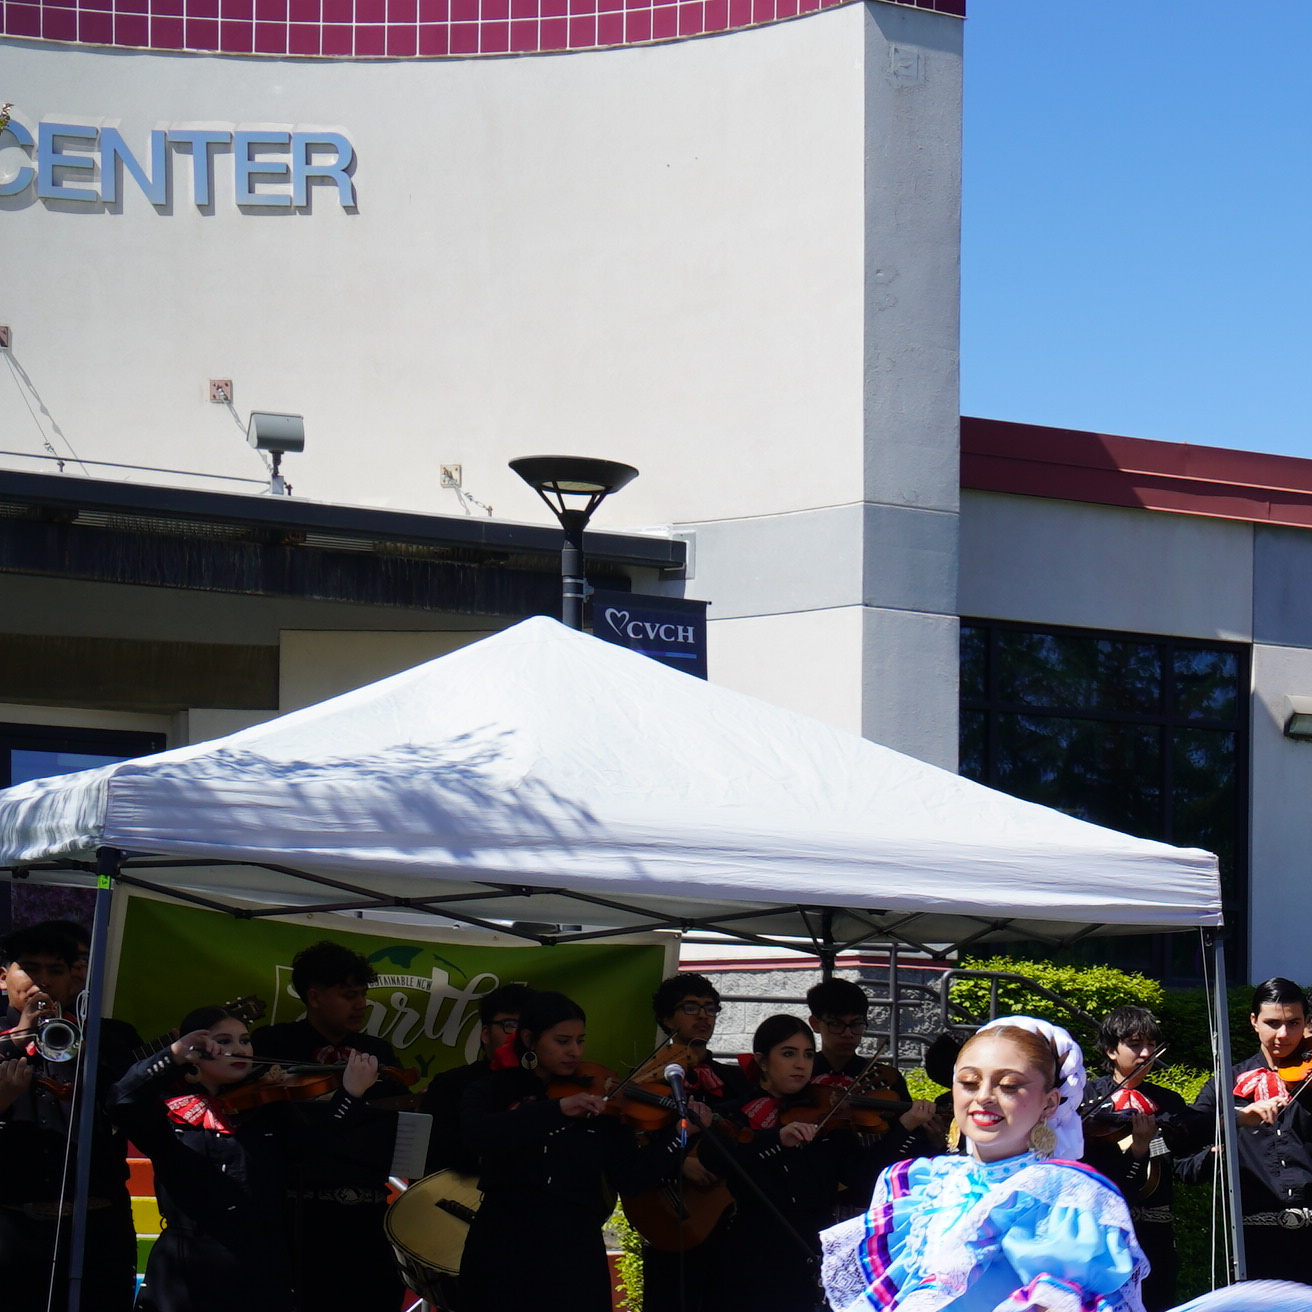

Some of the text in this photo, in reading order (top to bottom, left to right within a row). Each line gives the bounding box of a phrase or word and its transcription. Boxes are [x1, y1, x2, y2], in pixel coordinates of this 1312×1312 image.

[627, 621, 695, 643] CVCH
[368, 975, 414, 988] STAINABLE
[286, 966, 499, 1064] arth
